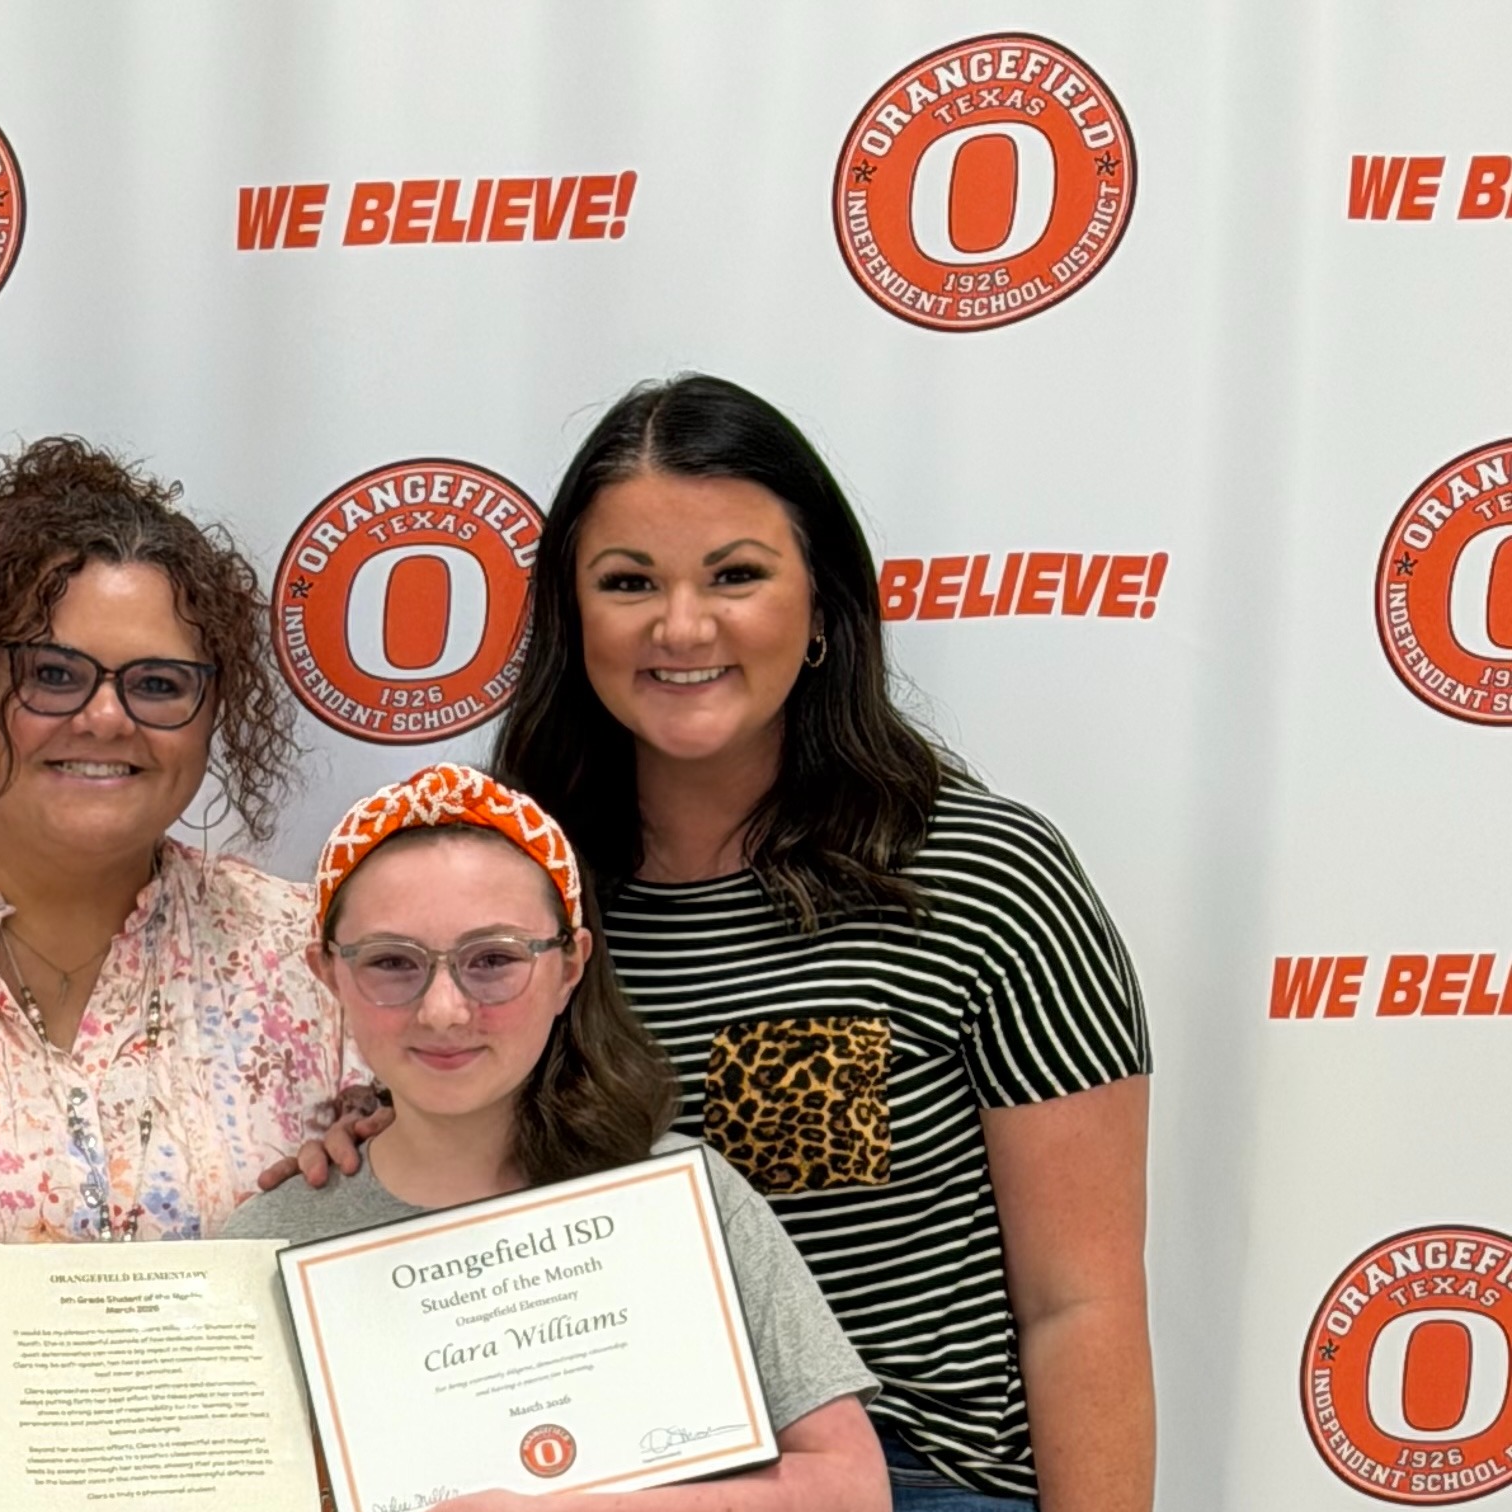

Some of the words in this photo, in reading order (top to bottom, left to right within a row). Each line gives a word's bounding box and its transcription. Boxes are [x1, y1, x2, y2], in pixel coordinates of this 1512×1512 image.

[861, 50, 1115, 156] ORANGEFIELD
[934, 89, 1045, 123] TEXAS
[237, 184, 329, 250] WE
[343, 171, 637, 247] BELIEVE!
[911, 122, 1056, 265] O
[1349, 156, 1445, 220] WE
[848, 191, 952, 316] INDEPENDENT
[957, 276, 1052, 317] SCHOOL
[1050, 182, 1120, 281] DISTRICT
[944, 269, 1010, 292] 1926
[368, 511, 478, 541] TEXAS
[347, 544, 487, 681] O
[877, 552, 1168, 621] BELIEVE!
[285, 605, 387, 729] INDEPENDENT
[392, 696, 484, 731] SCHOOL
[1389, 583, 1487, 709] INDEPENDENT
[380, 686, 443, 707] 1926
[1270, 956, 1367, 1019] WE
[49, 1273, 130, 1283] ORANGEFIELD
[392, 1228, 557, 1289] Orangefield
[564, 1215, 615, 1247] ISD
[420, 1286, 488, 1314] Student
[492, 1279, 509, 1297] of
[513, 1274, 541, 1292] the
[544, 1257, 604, 1283] Month
[455, 1303, 518, 1327] Orangefield
[519, 1290, 579, 1312] Elementary
[1389, 1277, 1501, 1307] TEXAS
[424, 1341, 499, 1372] Clara
[504, 1307, 629, 1349] Williams
[509, 1402, 544, 1417] March
[546, 1395, 572, 1409] 2026
[1369, 1308, 1510, 1441] O
[1315, 1368, 1405, 1489] INDEPENDENT
[1411, 1459, 1506, 1492] SCHOOL
[1397, 1448, 1463, 1468] 1926
